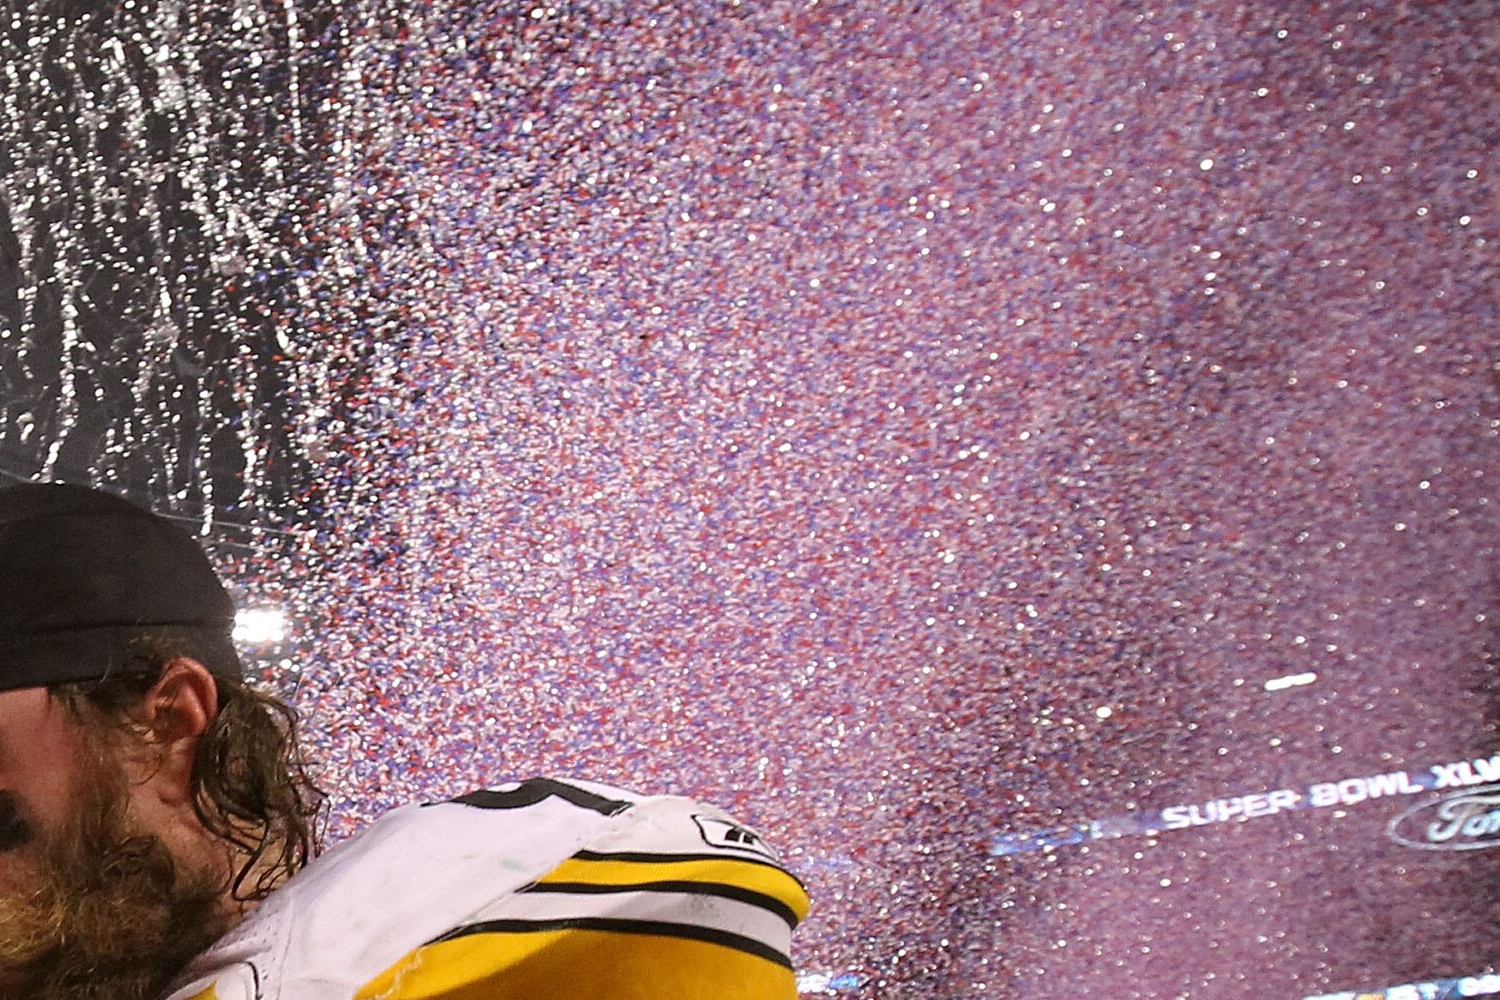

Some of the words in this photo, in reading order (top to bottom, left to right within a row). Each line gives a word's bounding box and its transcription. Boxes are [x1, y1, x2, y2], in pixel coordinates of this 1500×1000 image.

[1161, 788, 1298, 830] SUPER
[1309, 771, 1424, 808] BOWL
[1430, 755, 1500, 788] XLV
